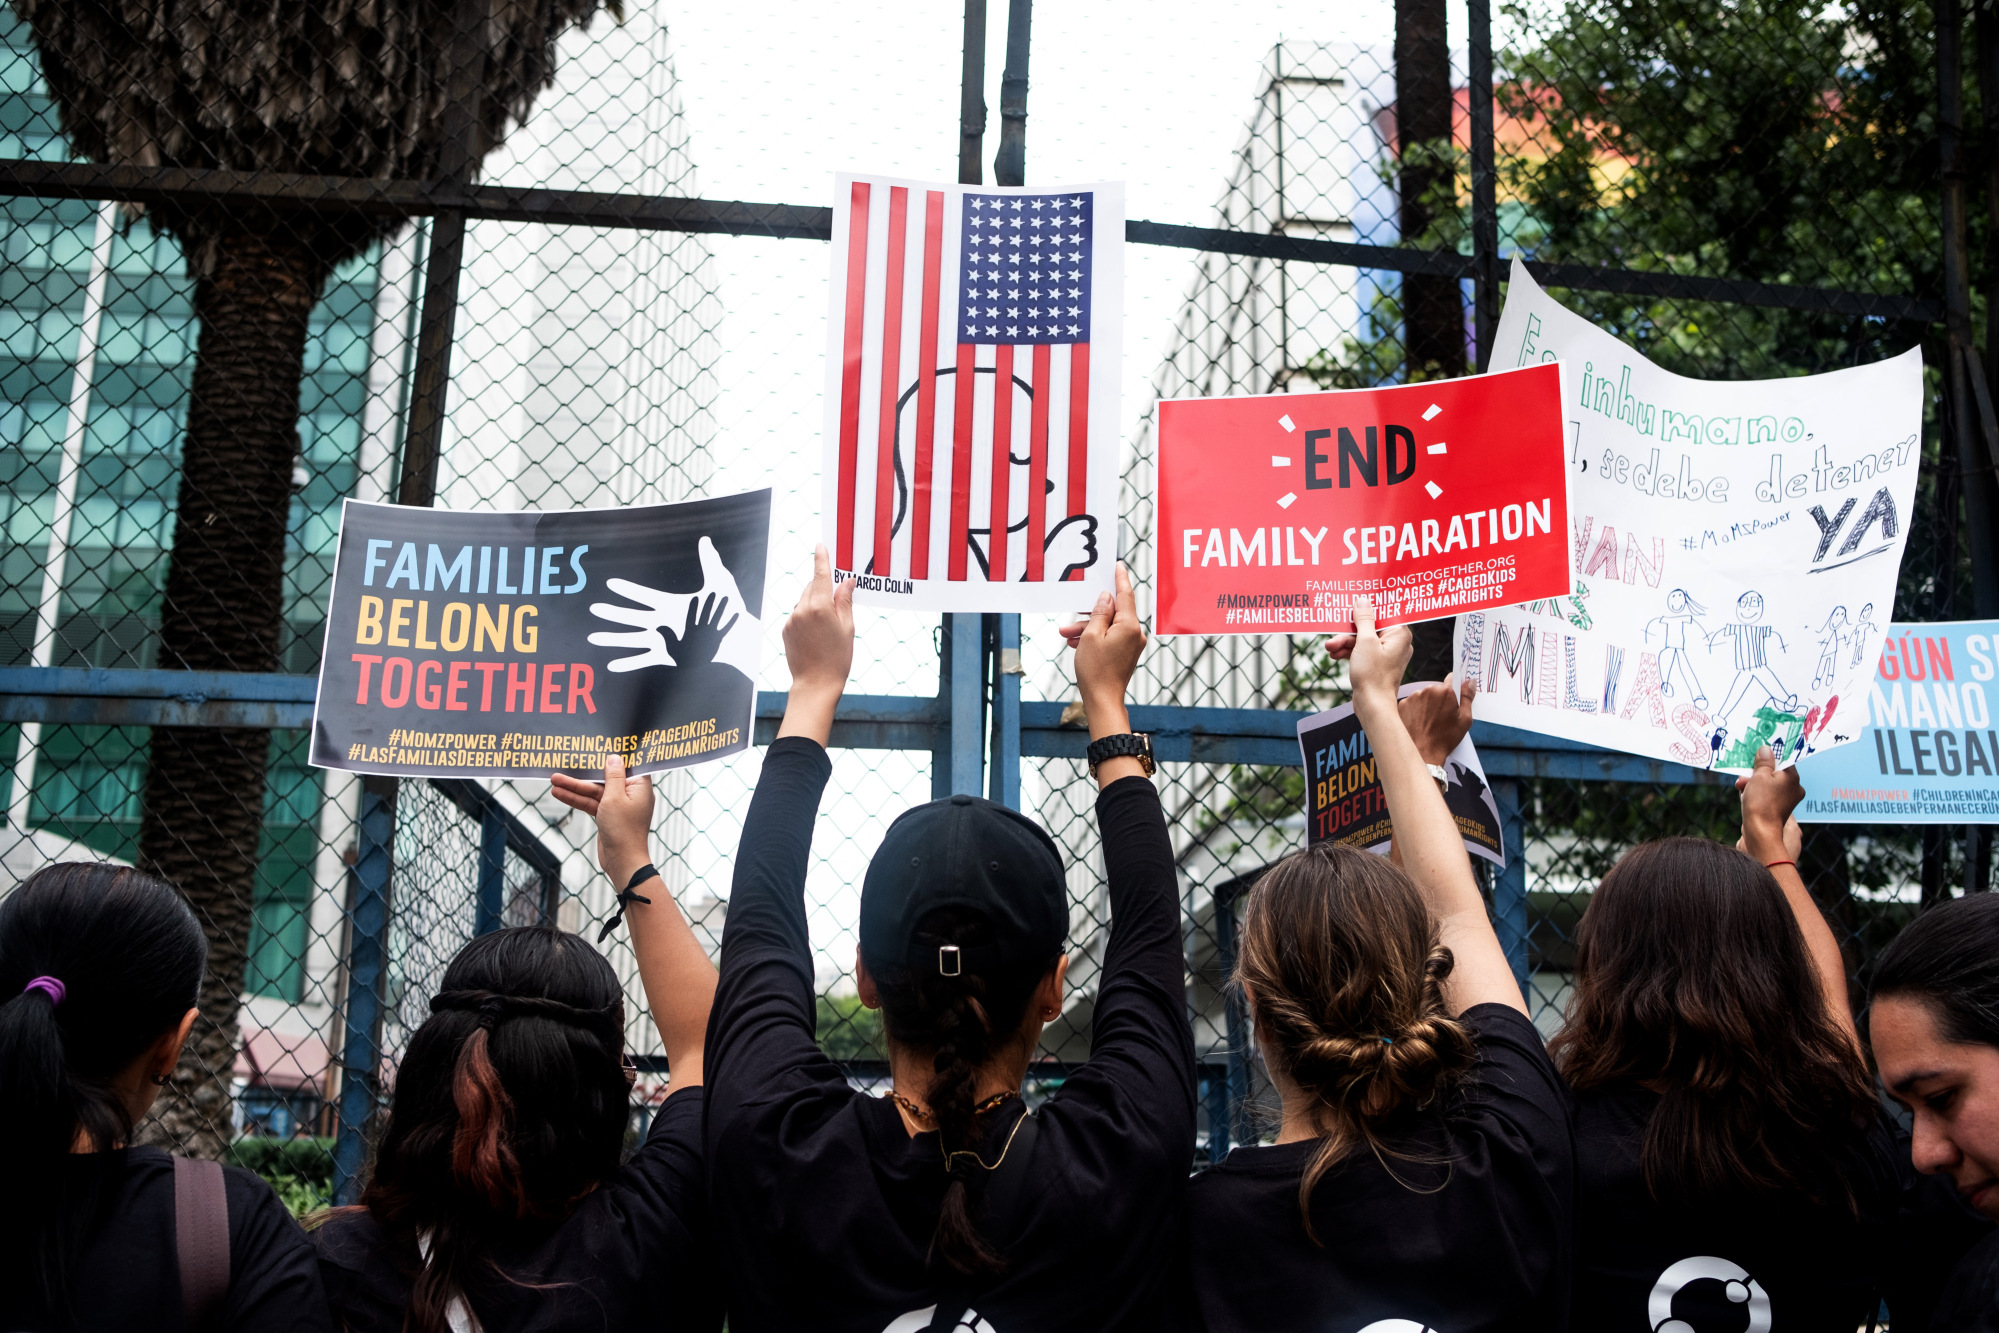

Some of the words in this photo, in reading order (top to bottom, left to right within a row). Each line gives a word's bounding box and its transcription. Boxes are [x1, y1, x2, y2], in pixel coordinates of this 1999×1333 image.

[1304, 424, 1417, 490] END
[1755, 434, 1917, 503] detener
[1183, 526, 1328, 568] FAMILY
[1342, 498, 1551, 565] SEPARATION
[1806, 486, 1899, 563] YA
[364, 538, 589, 595] FAMILIES
[1306, 555, 1515, 591] FAMILIESBELONGTOGETHER.ORG
[356, 595, 539, 653] BELONG
[351, 654, 597, 714] TOGETHER
[1862, 682, 1990, 729] MANO
